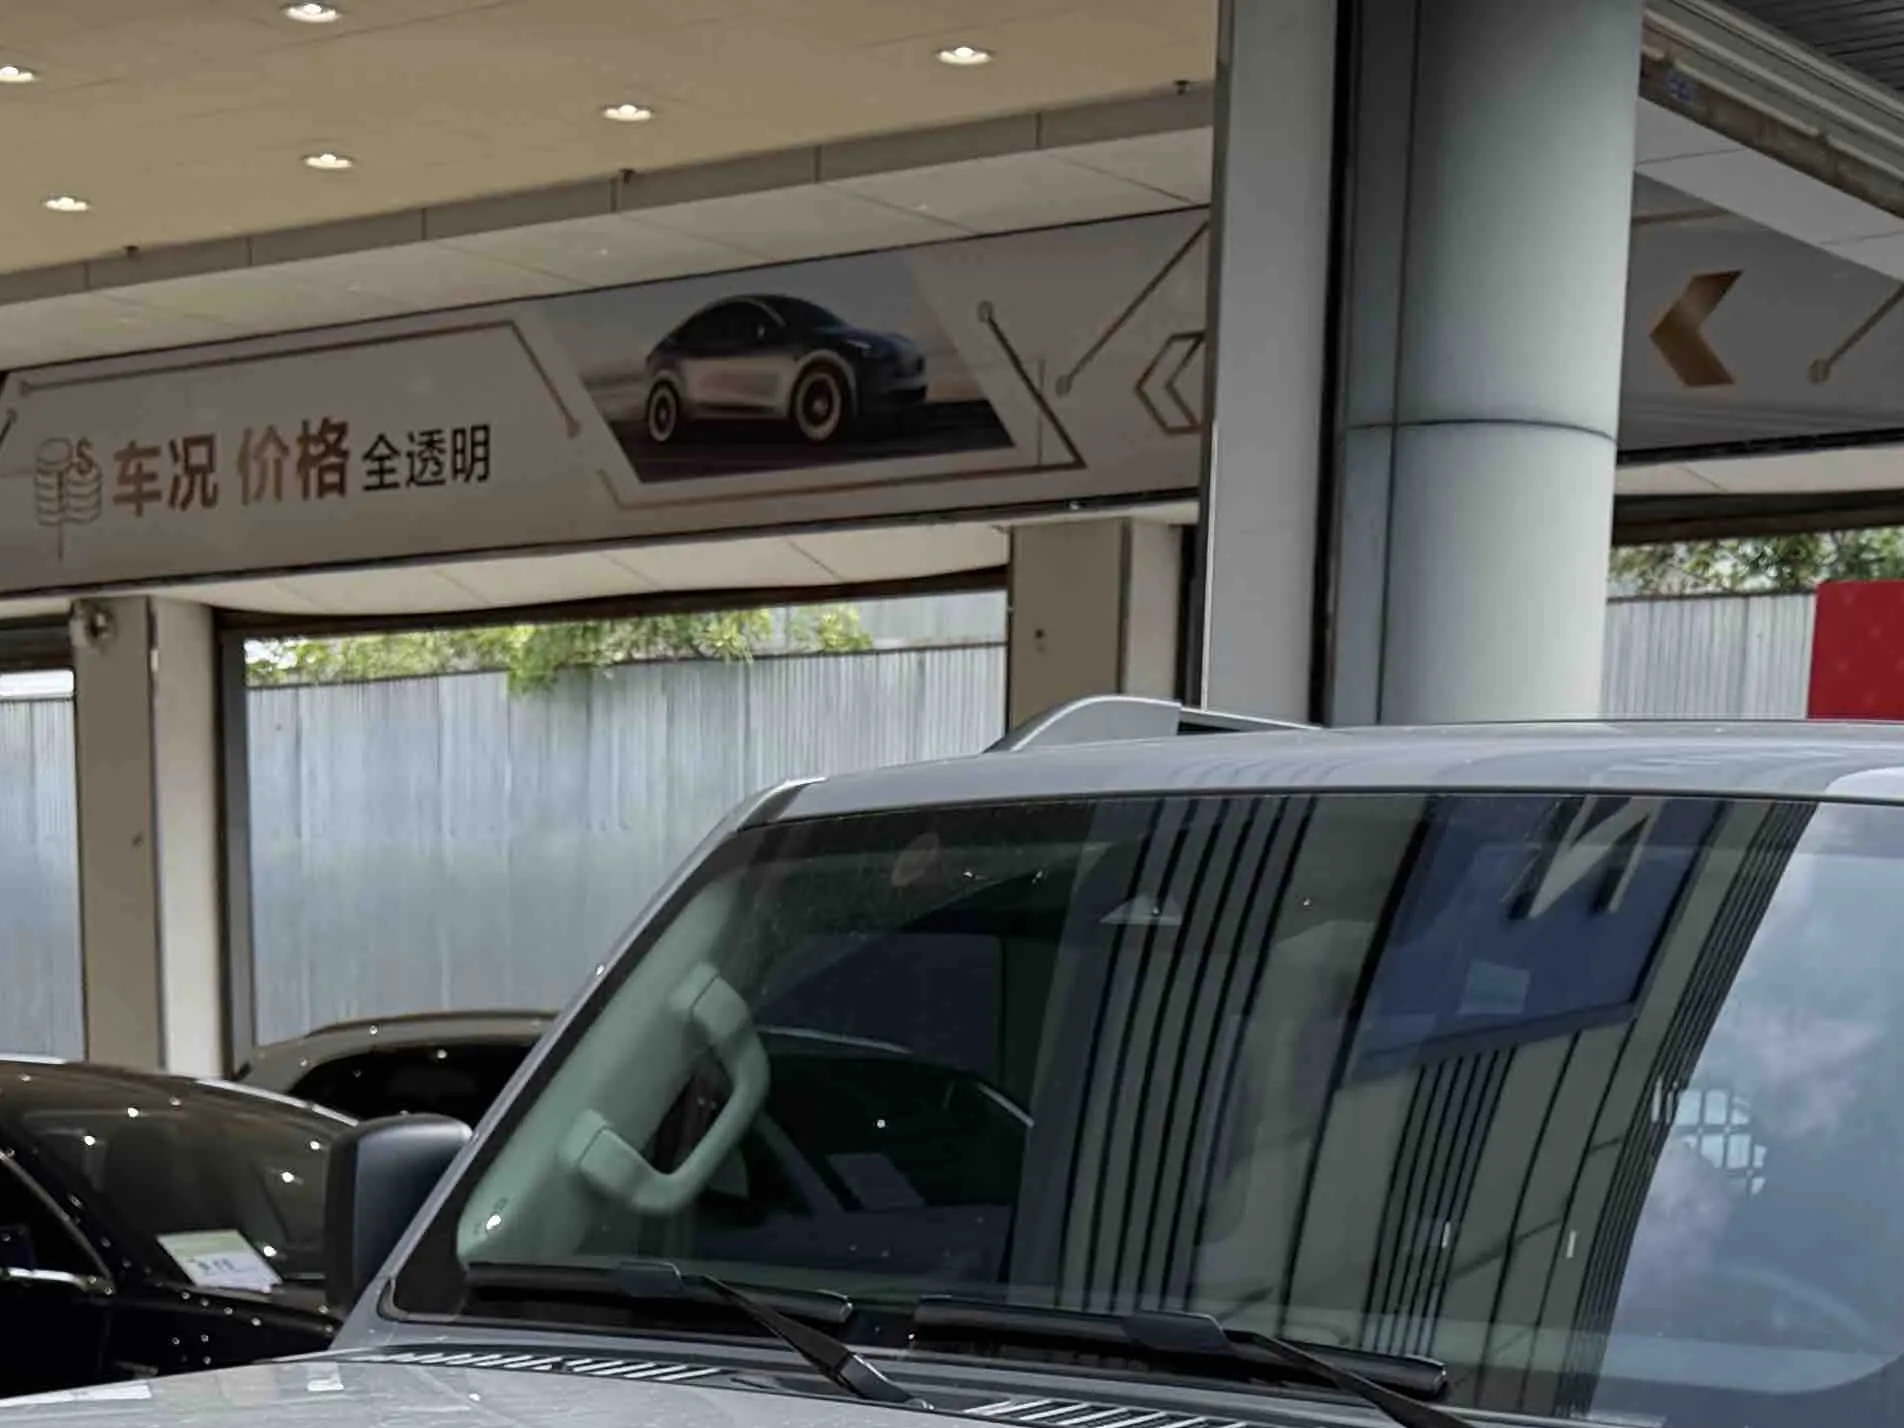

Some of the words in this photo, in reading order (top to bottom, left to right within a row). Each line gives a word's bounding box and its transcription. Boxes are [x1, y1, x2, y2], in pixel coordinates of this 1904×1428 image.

[112, 433, 220, 518] 车况
[236, 415, 352, 507] 价格
[360, 423, 492, 493] 全透明
